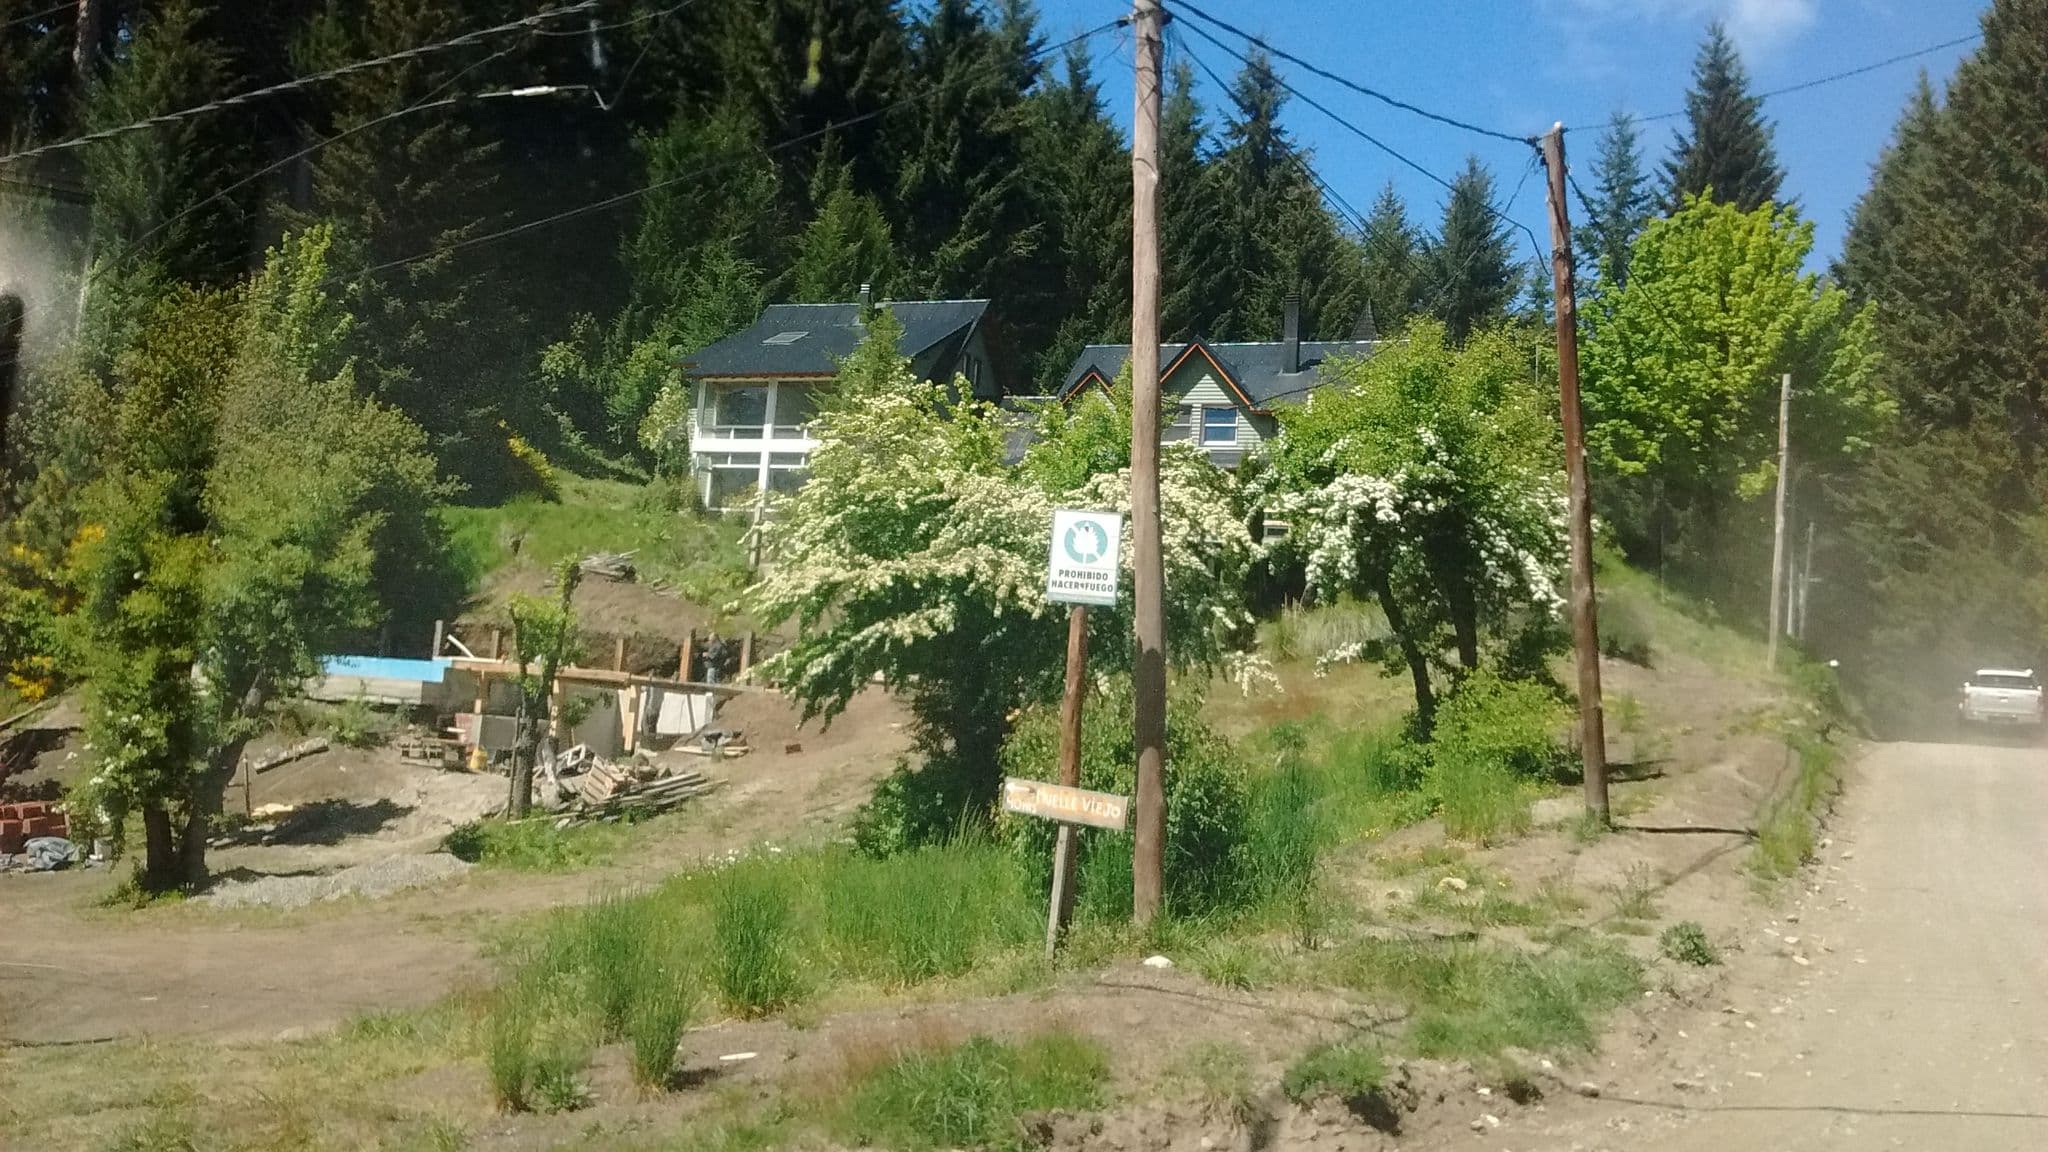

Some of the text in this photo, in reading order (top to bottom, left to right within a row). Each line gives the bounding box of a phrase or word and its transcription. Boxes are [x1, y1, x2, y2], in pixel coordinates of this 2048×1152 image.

[1058, 569, 1109, 581] PROHIBIDO
[1051, 580, 1114, 592] HACER FUEGO
